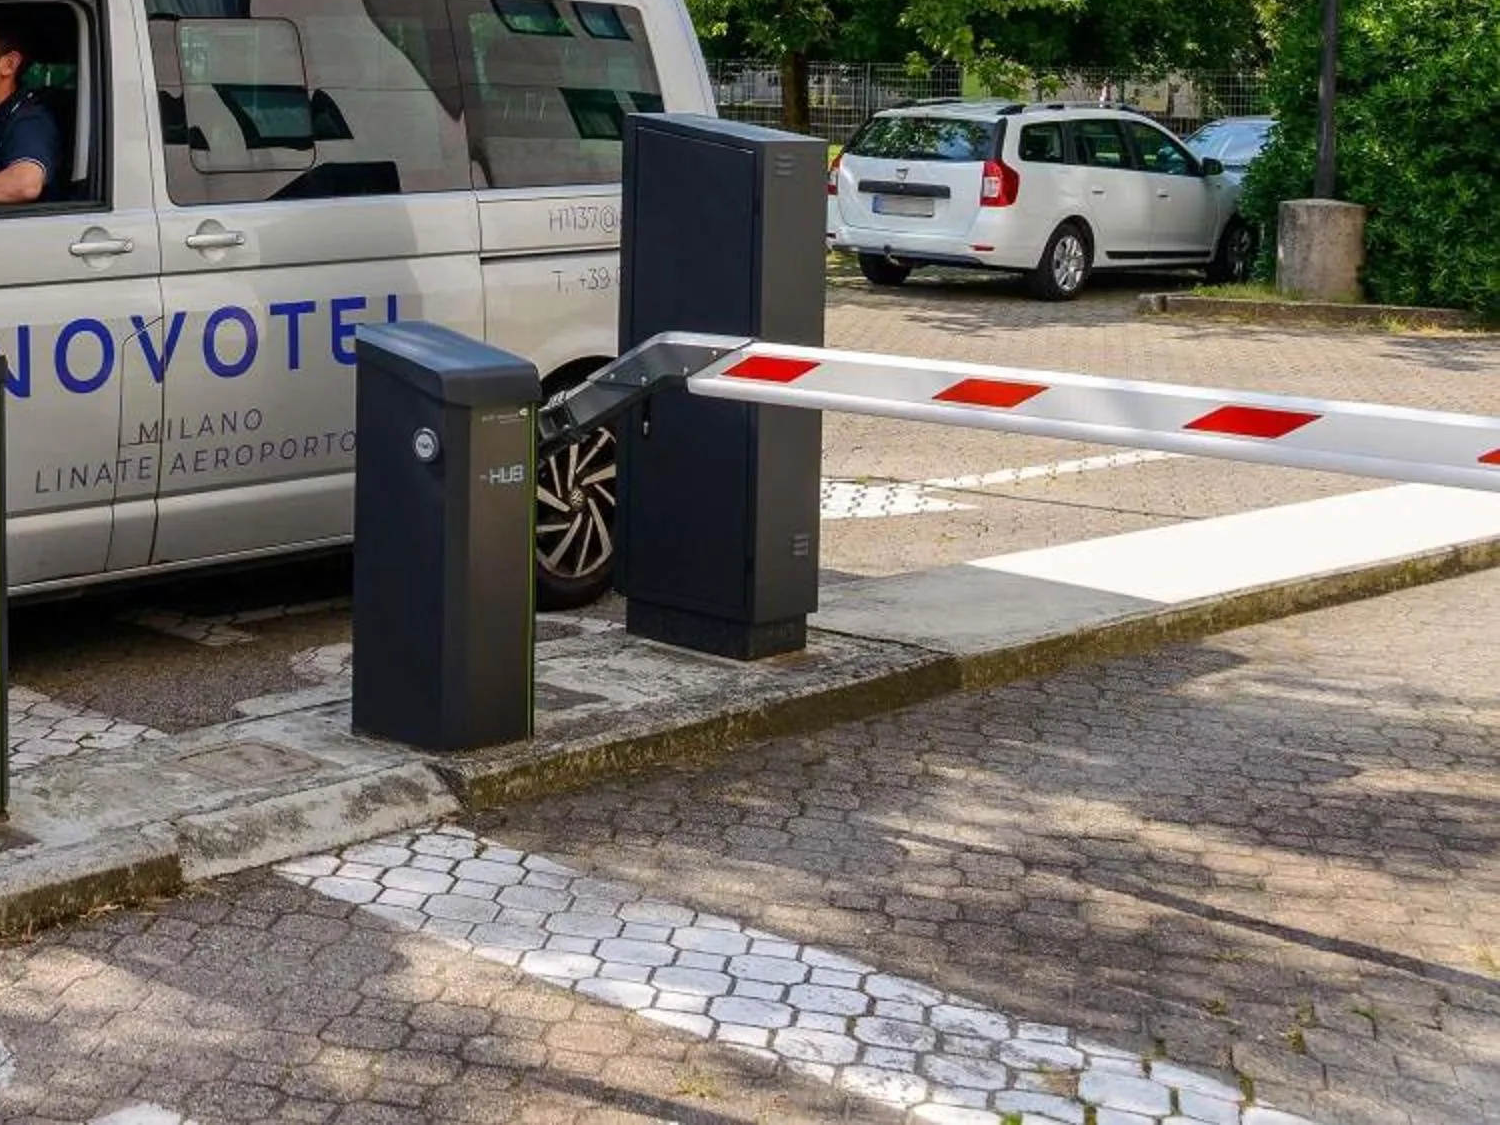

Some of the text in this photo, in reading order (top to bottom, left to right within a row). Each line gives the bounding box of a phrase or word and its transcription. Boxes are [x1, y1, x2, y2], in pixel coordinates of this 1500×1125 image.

[138, 408, 263, 443] MILANO
[34, 429, 356, 494] LINATE AEROPORTO
[489, 464, 524, 484] HUB
